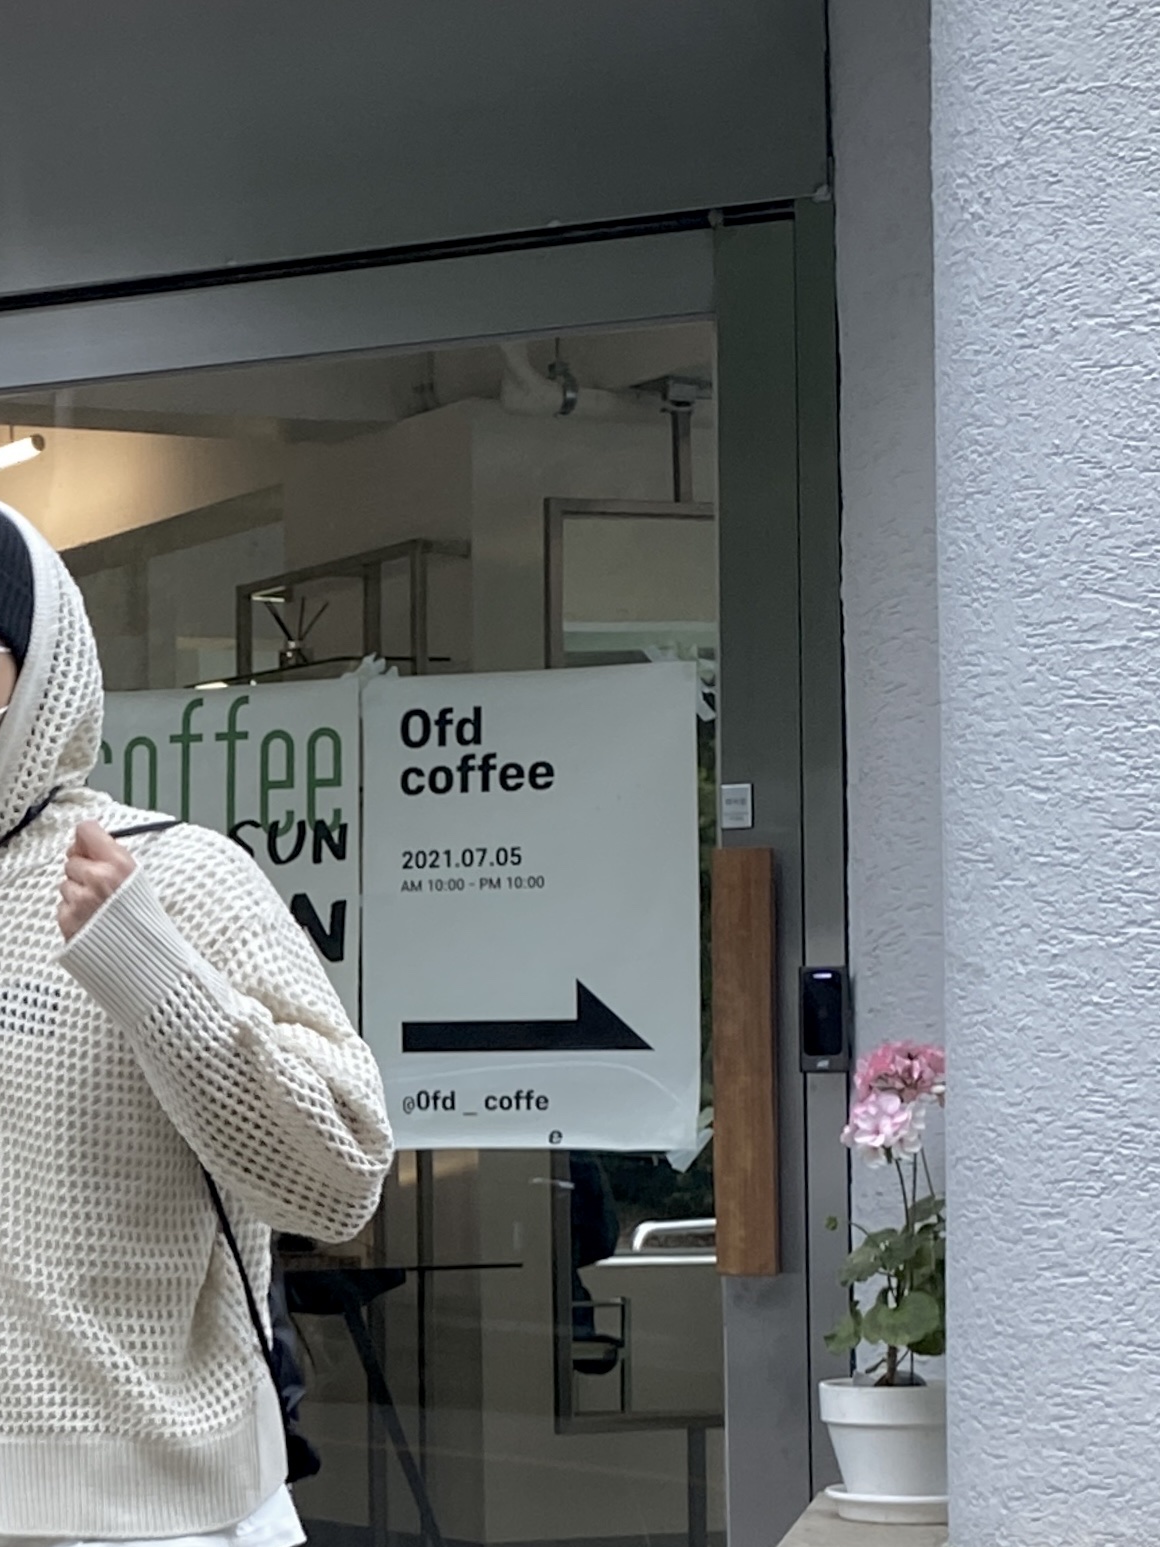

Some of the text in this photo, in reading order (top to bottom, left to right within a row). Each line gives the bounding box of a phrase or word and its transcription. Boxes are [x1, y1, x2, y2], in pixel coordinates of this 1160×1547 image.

[101, 695, 342, 837] offee
[400, 753, 555, 796] coffee
[227, 819, 348, 865] SUN
[402, 847, 522, 870] 2021.07.05
[401, 880, 423, 893] AM
[428, 878, 466, 892] 10:00
[479, 877, 502, 891] PM
[507, 876, 545, 890] 10:00
[549, 1130, 563, 1144] e
